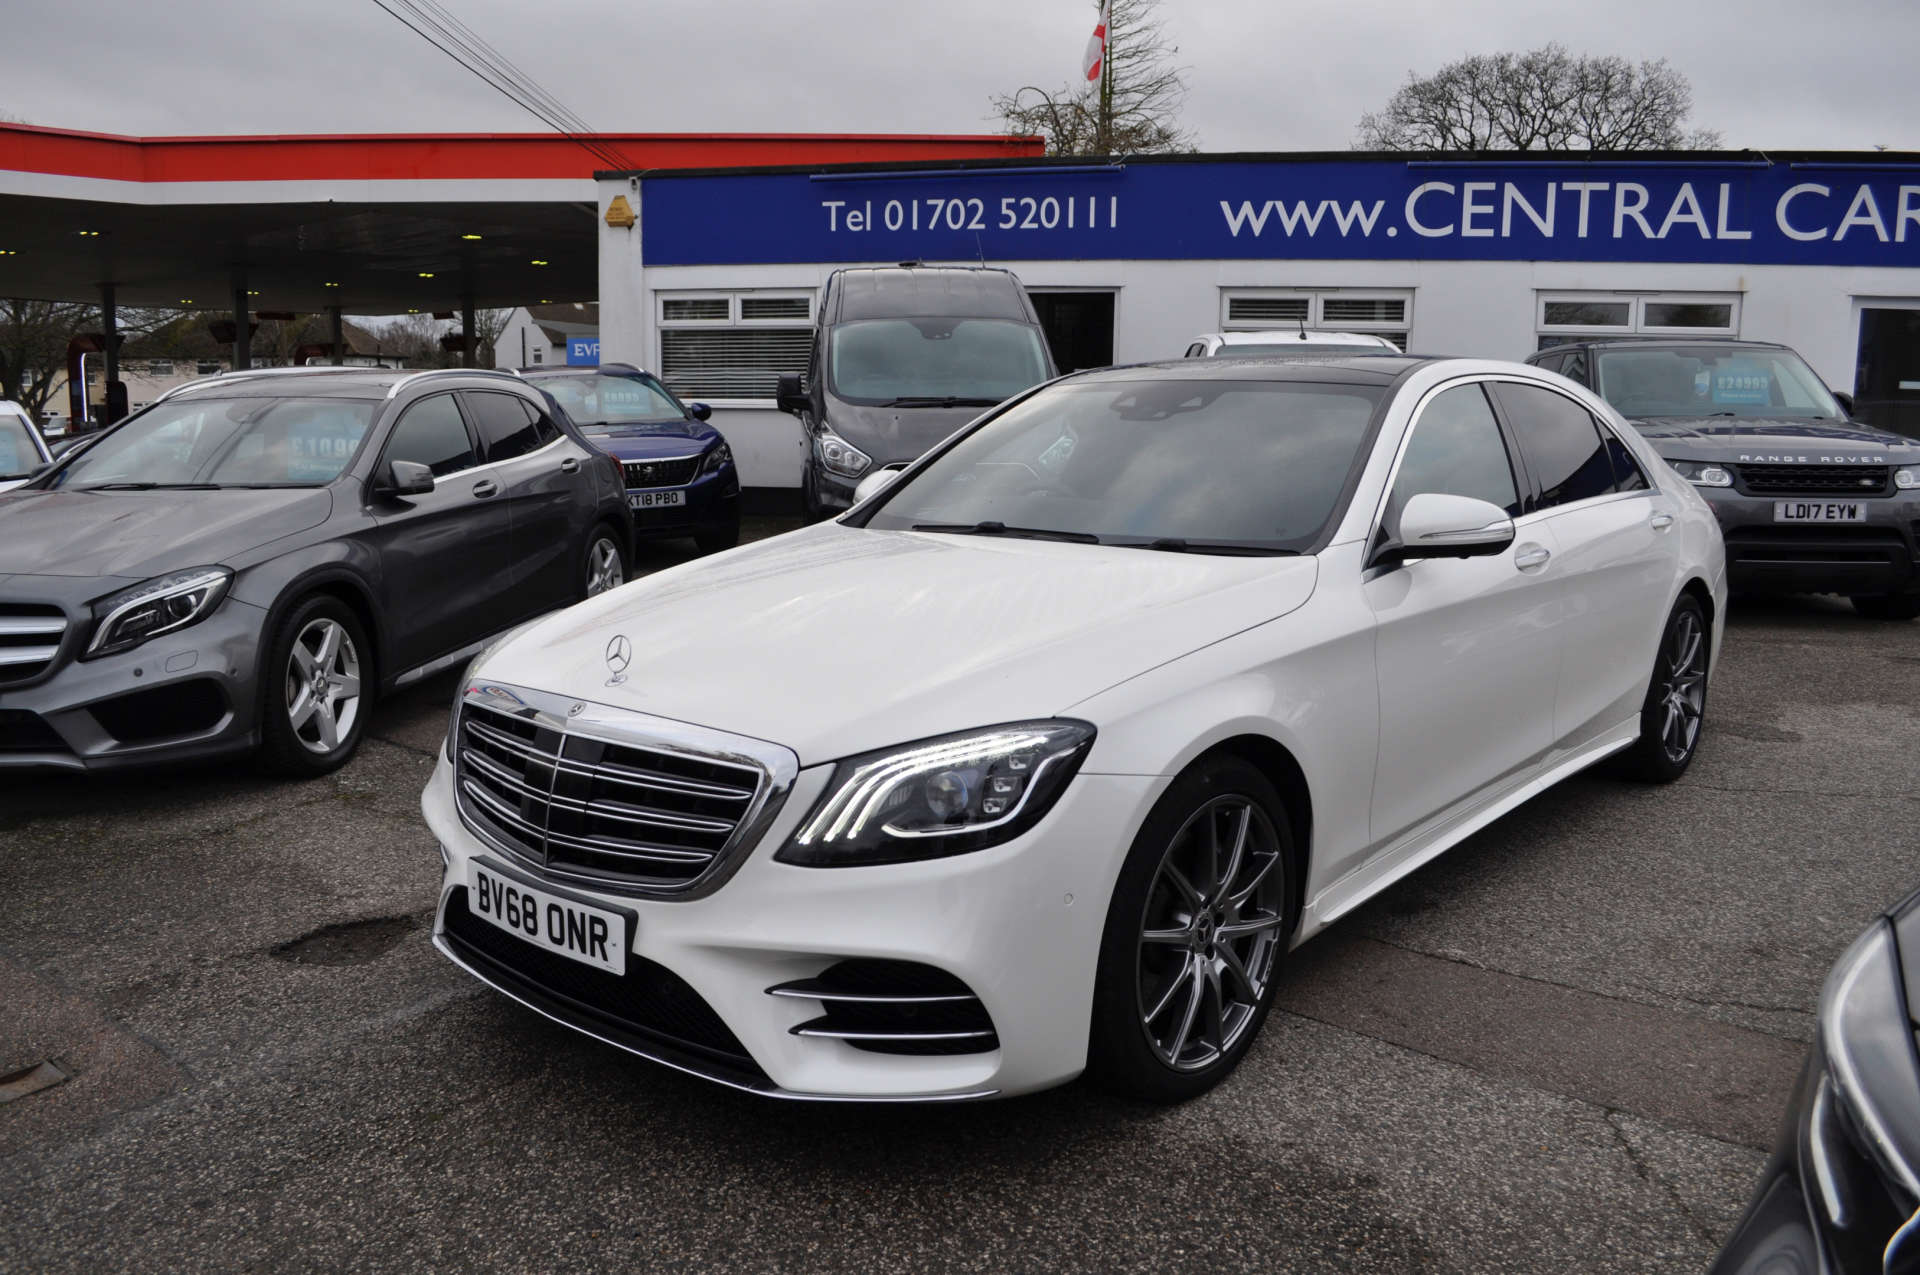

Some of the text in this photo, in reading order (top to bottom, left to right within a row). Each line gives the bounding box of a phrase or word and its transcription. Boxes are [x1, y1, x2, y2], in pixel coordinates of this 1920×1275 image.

[822, 196, 1118, 232] Tel 01702 520111
[1740, 454, 1807, 463] RANGE
[1784, 503, 1857, 519] LD17 EYW
[477, 871, 609, 962] BV68 ONR
